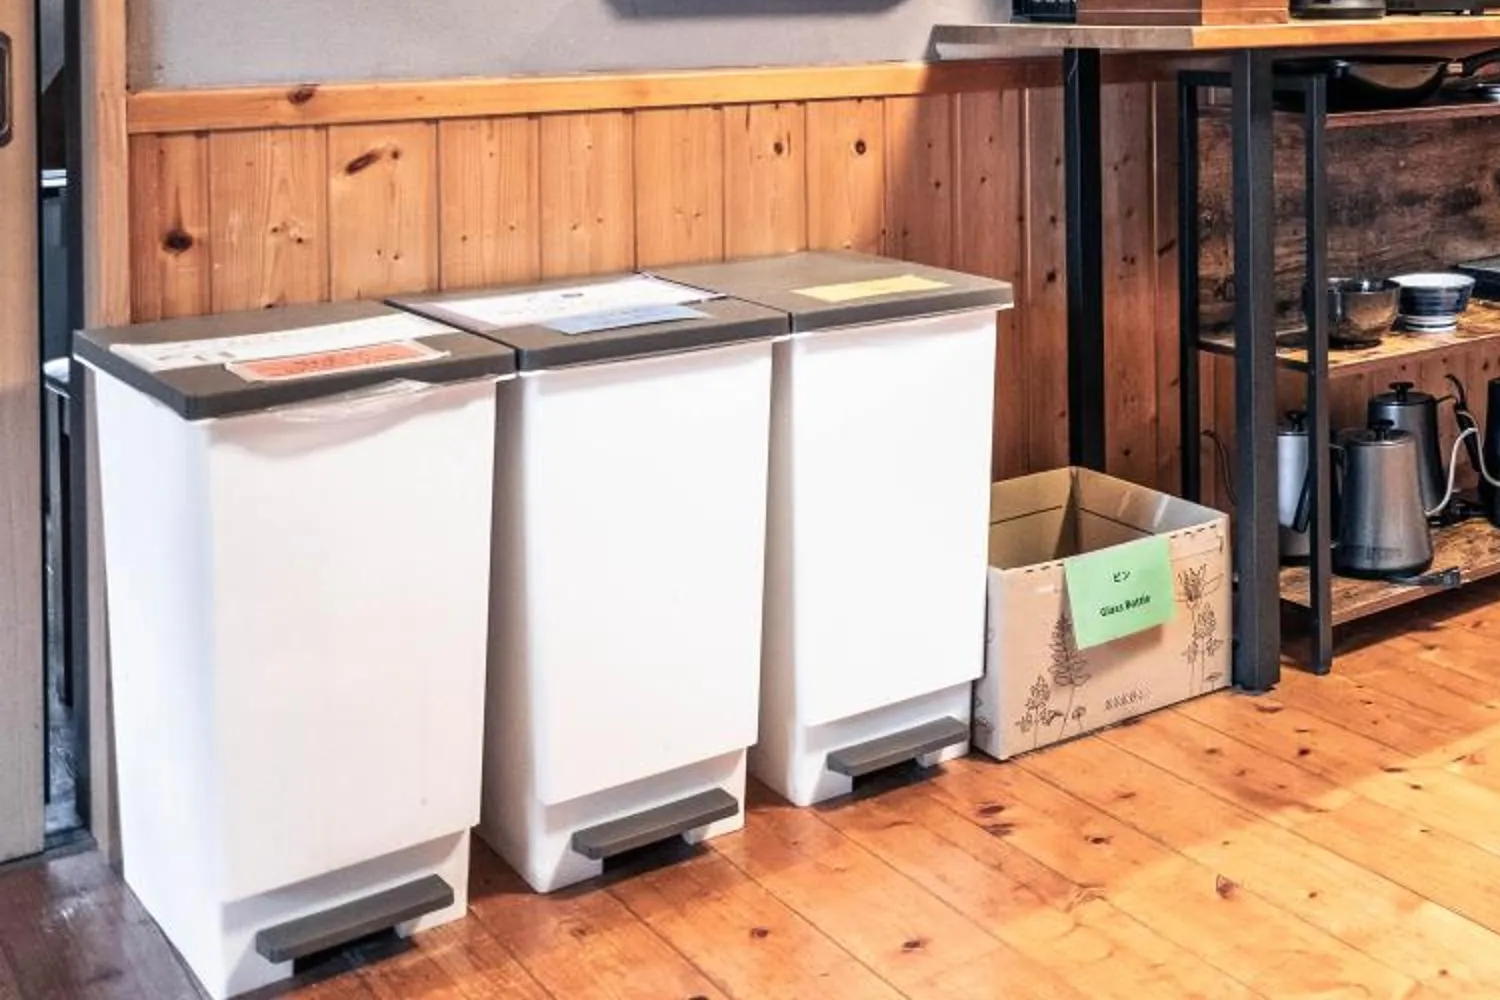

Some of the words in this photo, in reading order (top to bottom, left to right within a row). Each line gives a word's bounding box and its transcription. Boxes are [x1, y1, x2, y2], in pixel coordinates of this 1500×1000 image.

[1113, 570, 1131, 583] ビン
[1100, 603, 1124, 617] Glass
[1124, 594, 1152, 610] Bottle
